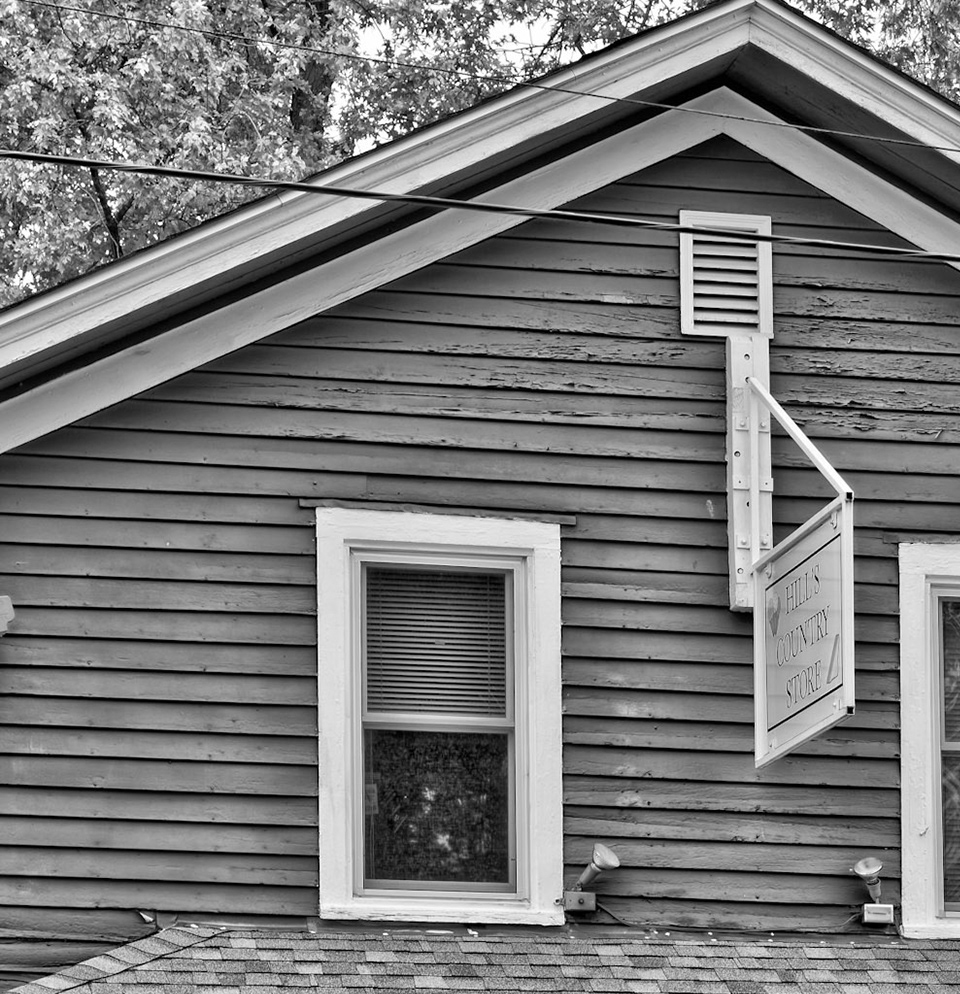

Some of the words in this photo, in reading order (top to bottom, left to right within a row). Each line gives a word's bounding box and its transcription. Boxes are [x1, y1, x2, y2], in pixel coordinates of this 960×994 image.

[785, 563, 821, 616] HILL'S
[776, 605, 830, 668] COUNTRY
[785, 660, 822, 708] STORE
